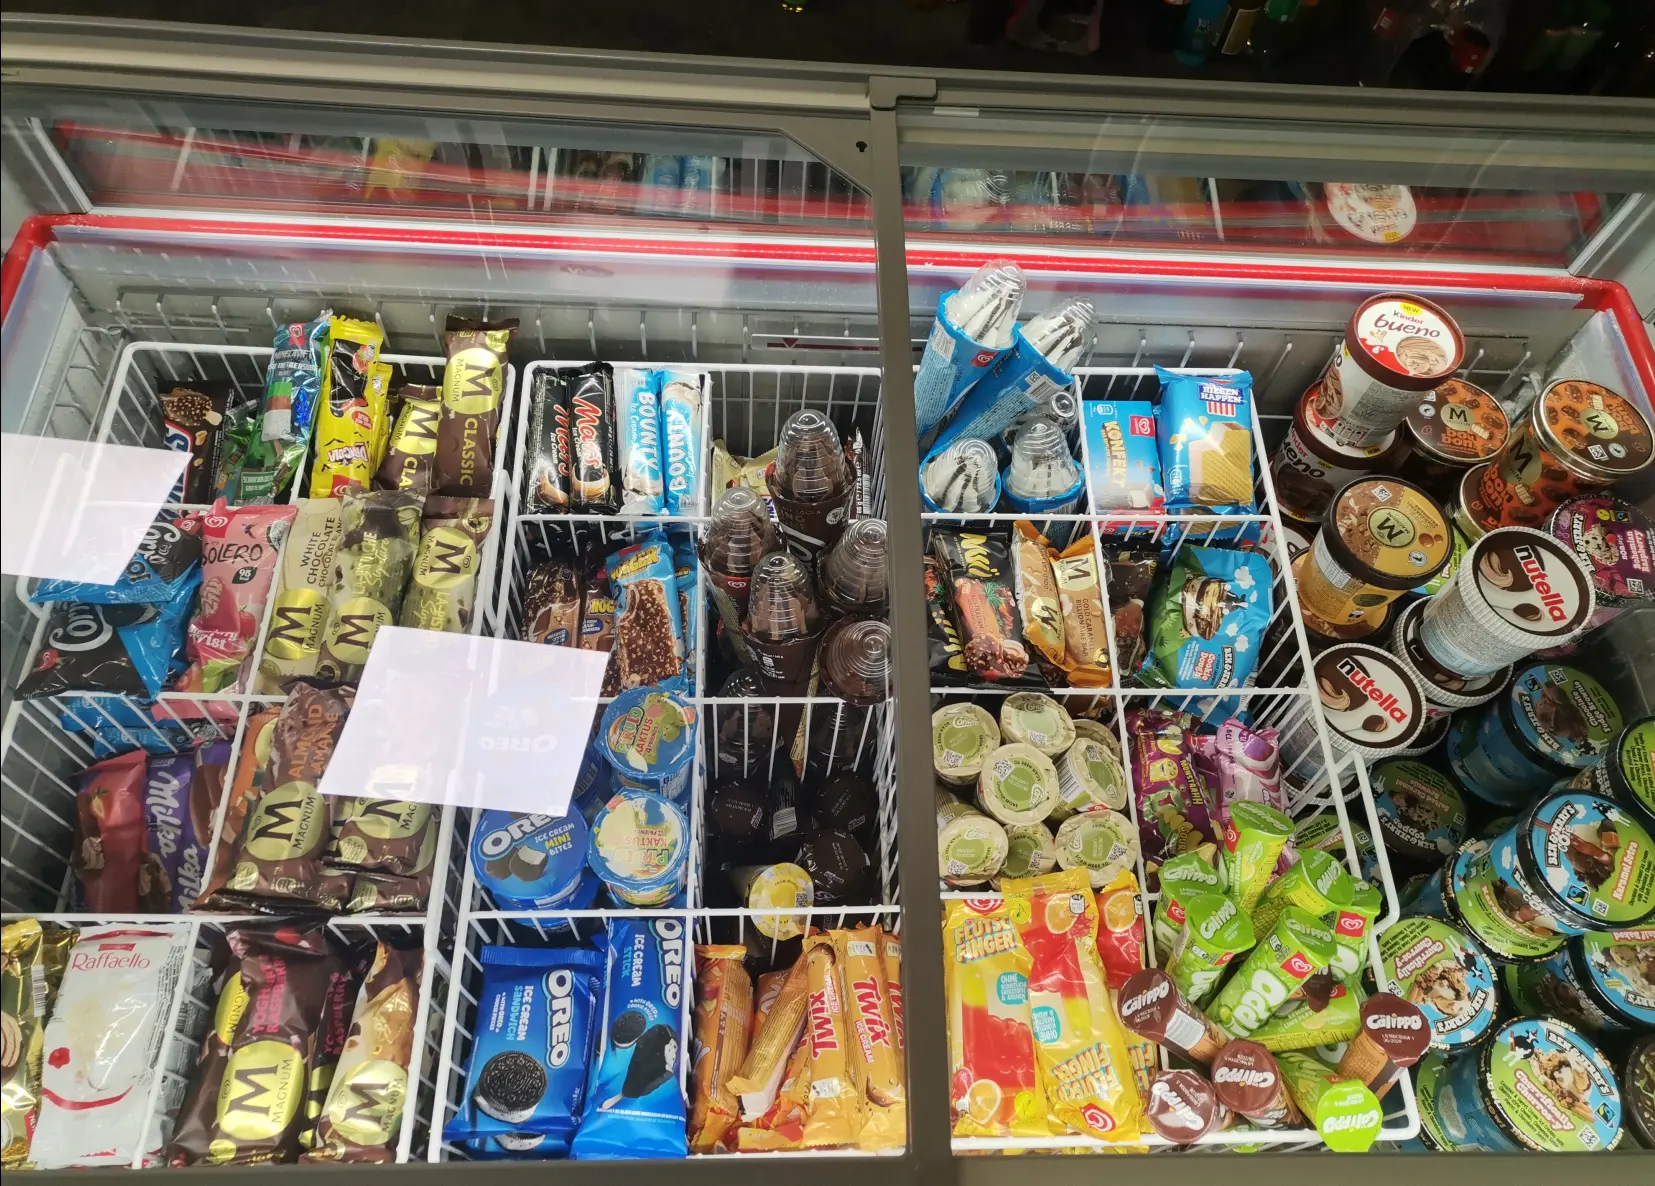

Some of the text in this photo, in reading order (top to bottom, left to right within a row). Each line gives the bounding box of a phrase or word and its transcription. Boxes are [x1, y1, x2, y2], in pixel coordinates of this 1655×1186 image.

[1373, 313, 1442, 339] bueno
[1393, 309, 1425, 326] Kinder
[451, 358, 464, 403] MAGNUM
[459, 362, 496, 397] M
[1200, 393, 1243, 404] HAPPEN
[1202, 385, 1240, 397] RIESEN
[405, 406, 438, 440] M
[572, 397, 602, 469] Mars
[638, 392, 659, 473] BOUNTY
[1450, 407, 1468, 423] M
[1586, 414, 1609, 433] M
[460, 417, 478, 486] CLASSIC
[665, 409, 688, 492] BOUNTY
[1102, 420, 1128, 488] KONFEKT
[1377, 516, 1405, 543] M
[1386, 511, 1411, 535] MAGNUM
[202, 543, 263, 567] SOLERO
[300, 531, 322, 568] WHITE
[307, 515, 336, 585] CHOCOLATE
[419, 535, 436, 577] MAGNUM
[430, 539, 469, 576] M
[1065, 557, 1091, 581] M
[1627, 530, 1642, 570] Bohemian
[1634, 529, 1650, 573] Raspberry
[1514, 545, 1568, 623] nutella
[269, 605, 313, 646] M
[306, 602, 325, 651] MAGNUM
[334, 613, 375, 650] M
[1075, 598, 1089, 658] BILLIONAIRE BAR
[1083, 598, 1097, 652] GOLD CARAMEL
[1337, 657, 1408, 724] nutella
[288, 704, 323, 778] ALMOND
[636, 718, 655, 756] KAKTUS
[1021, 761, 1033, 769] HERE
[1031, 768, 1042, 782] SCAN
[146, 770, 183, 859] Milka
[251, 799, 304, 844] M
[292, 794, 318, 850] MAGNUM
[1004, 798, 1019, 808] MORE
[534, 822, 576, 844] ICE CREAM
[544, 833, 572, 849] MINI
[549, 841, 574, 857] BITES
[1177, 826, 1190, 853] SOUR
[1074, 854, 1087, 866] SCAN
[1612, 841, 1638, 901] Karamel Sutra
[953, 915, 1013, 947] FLUTSC
[1199, 899, 1238, 940] Calippo
[1613, 930, 1637, 942] Baked
[72, 951, 151, 971] Raffaello
[620, 946, 634, 979] STICK
[631, 933, 646, 987] ICE CREAM
[655, 917, 685, 1008] OREO
[955, 932, 1019, 964] FINGER
[1395, 937, 1433, 968] Churros-y
[1396, 940, 1444, 980] Churrifically
[824, 973, 840, 1015] ICE CREAM
[1000, 973, 1019, 984] OHNE
[1121, 979, 1170, 1017] Calippo
[505, 985, 523, 1041] SANDWICH
[516, 985, 535, 1042] ICE CREAM
[547, 969, 574, 1068] OREO
[809, 990, 839, 1060] TWIX
[853, 976, 892, 1047] TWIX
[1366, 1013, 1423, 1030] Calippo
[854, 1019, 875, 1063] ICE CREAM
[1051, 1040, 1114, 1082] FINGER
[224, 1064, 280, 1117] M
[272, 1058, 294, 1125] MAGNUM
[1055, 1064, 1122, 1104] FLUTSCH
[1215, 1066, 1275, 1089] Calippo
[343, 1083, 390, 1123] M
[383, 1076, 404, 1133] MAGNUM
[1151, 1081, 1205, 1131] Calippo
[1515, 1069, 1576, 1130] Churrifically
[1516, 1081, 1563, 1130] Churros-y
[1323, 1108, 1380, 1135] Calippo
